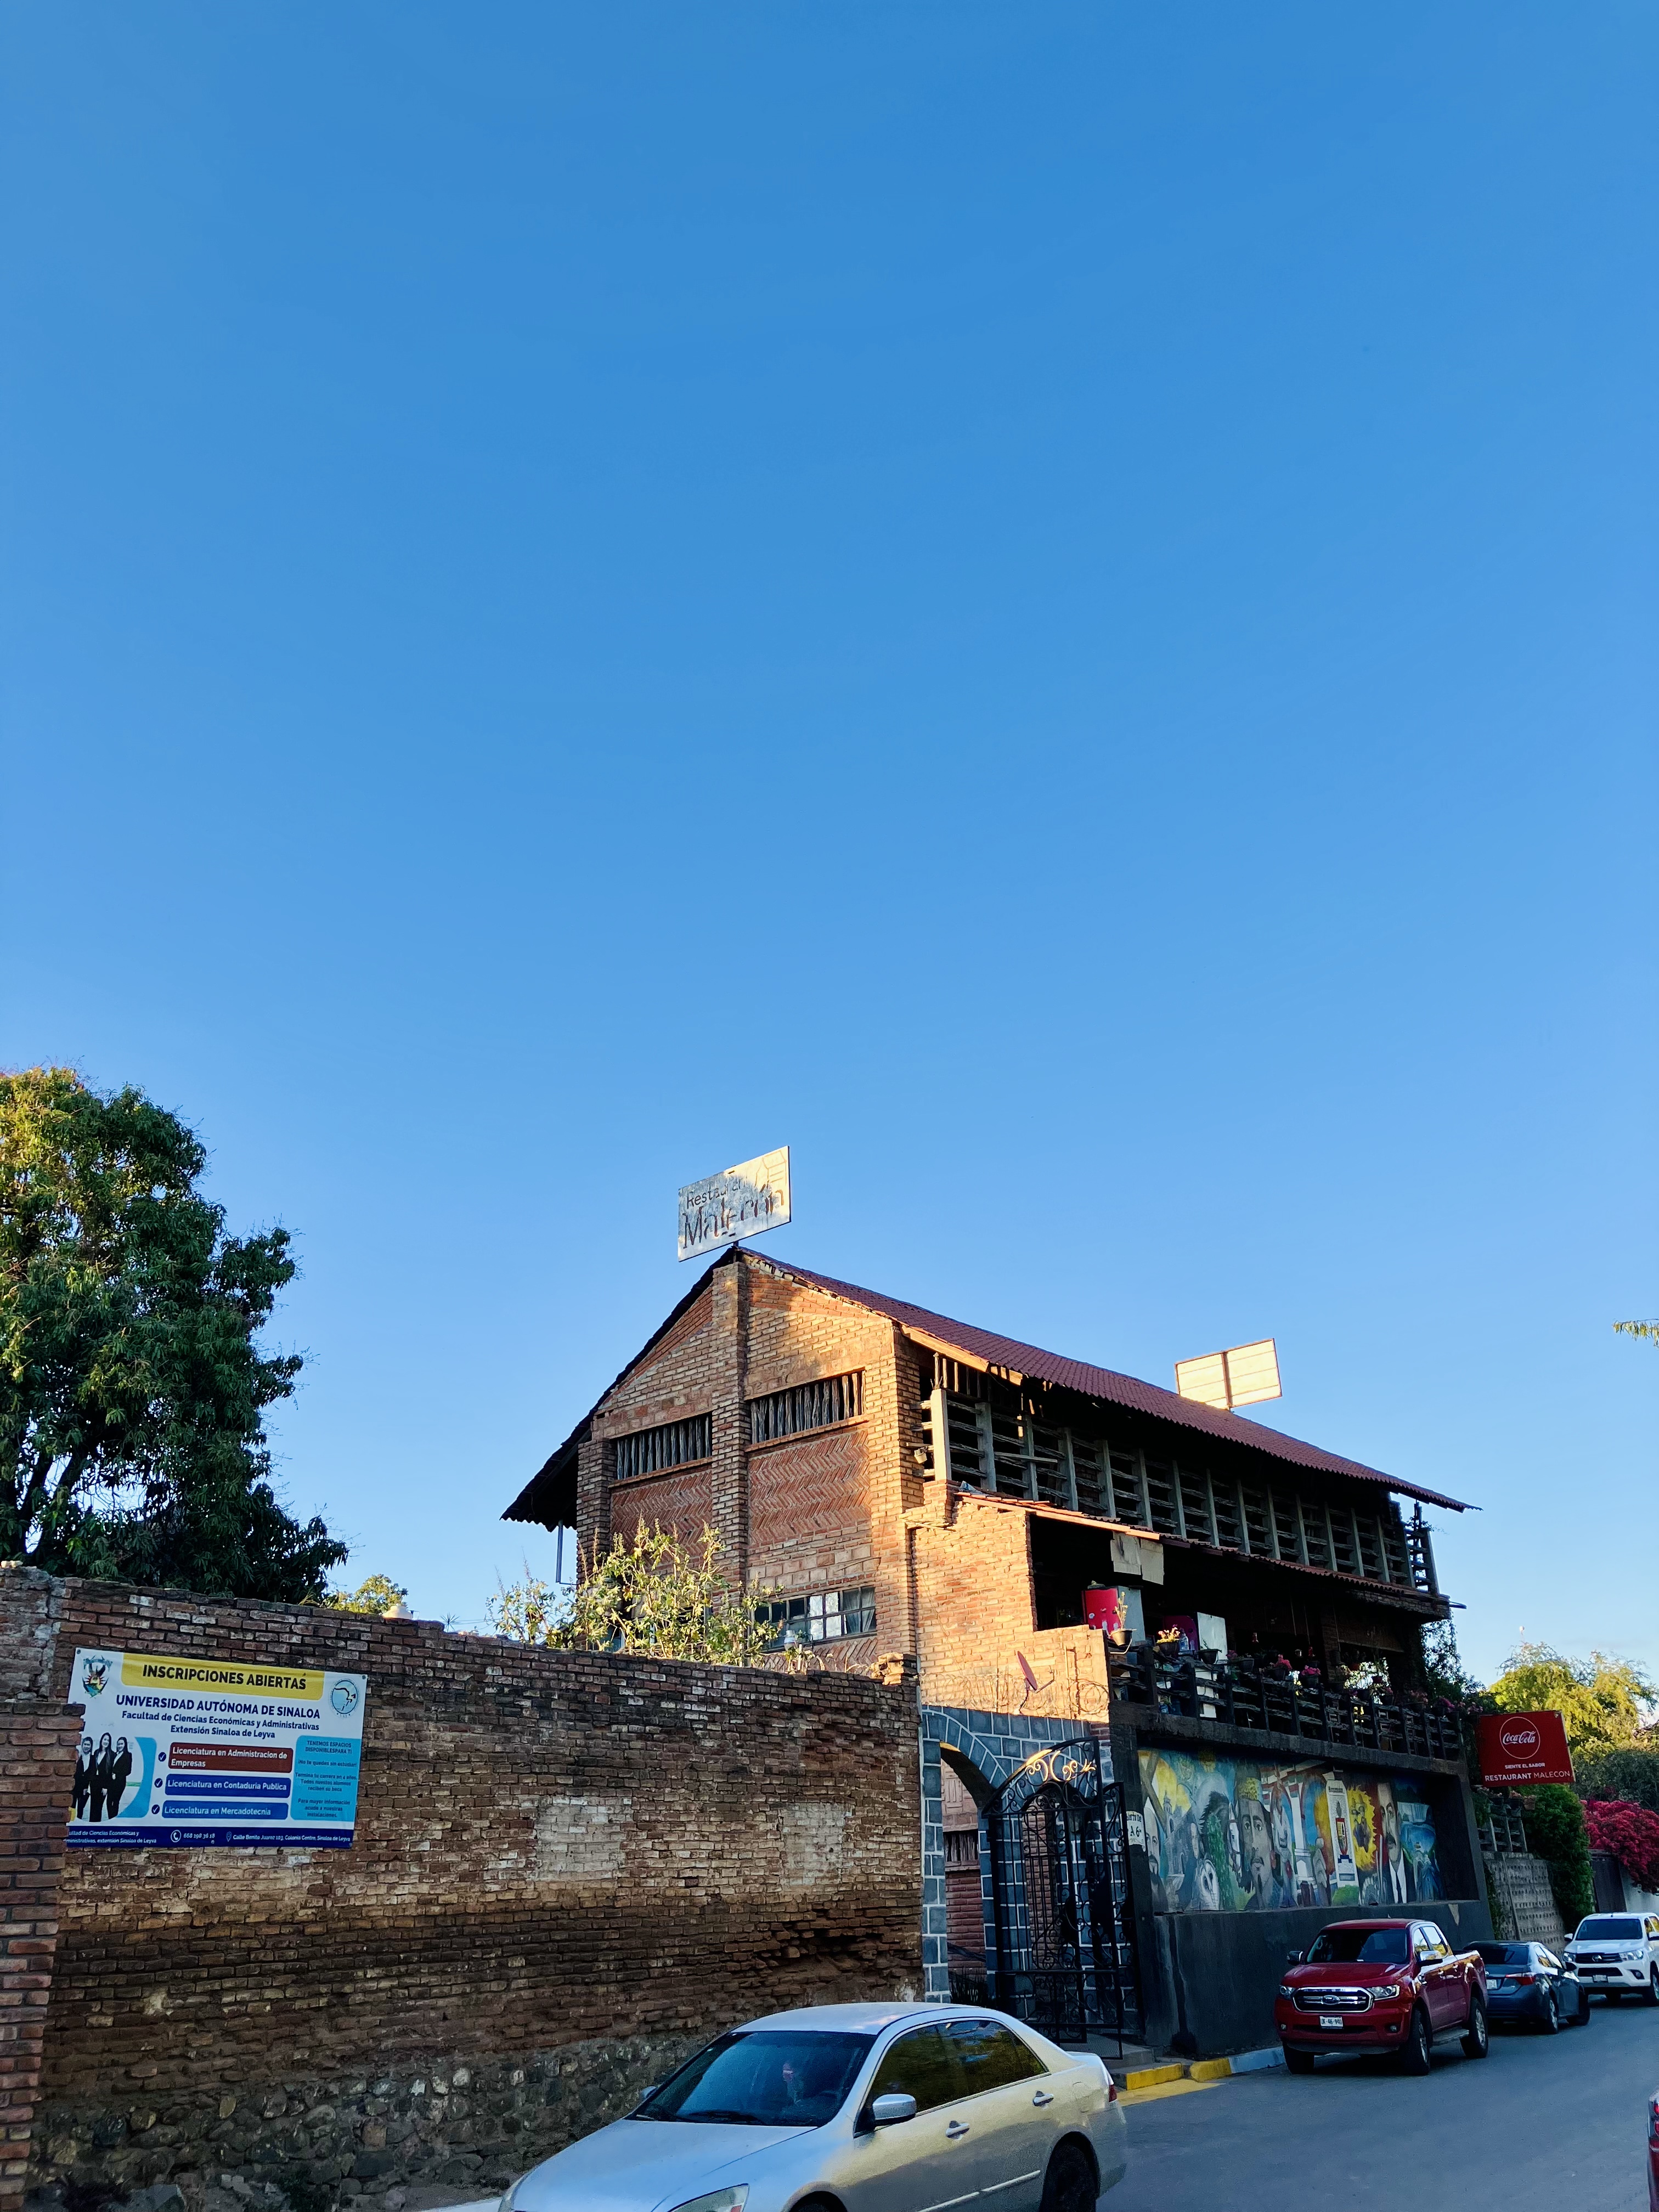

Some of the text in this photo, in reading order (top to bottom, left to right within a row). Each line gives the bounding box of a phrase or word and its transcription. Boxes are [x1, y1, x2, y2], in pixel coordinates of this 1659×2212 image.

[143, 1664, 306, 1690] INSCRIPCIONES ABIERTAS
[116, 1695, 320, 1719] UNIVERSIDAD AUTÓNOMA DE SINALOA
[122, 1711, 159, 1720] Facultad
[161, 1713, 172, 1721] de
[174, 1714, 207, 1723] Ciencias
[209, 1716, 255, 1726] Económicas
[262, 1719, 319, 1730] Administrativas
[170, 1725, 210, 1734] Extensión
[211, 1728, 240, 1736] Sinaloa
[253, 1730, 275, 1740] Leyva
[1503, 1731, 1536, 1745] Coca-Cola
[172, 1747, 216, 1756] Licenciatura
[228, 1749, 277, 1759] Administracion
[171, 1758, 206, 1768] Empresas
[1485, 1770, 1570, 1781] RESTAURANT MALECON
[167, 1780, 212, 1788] Licenciatura
[164, 1806, 209, 1814] Licenciatura
[221, 1807, 271, 1815] Mercadotecnia
